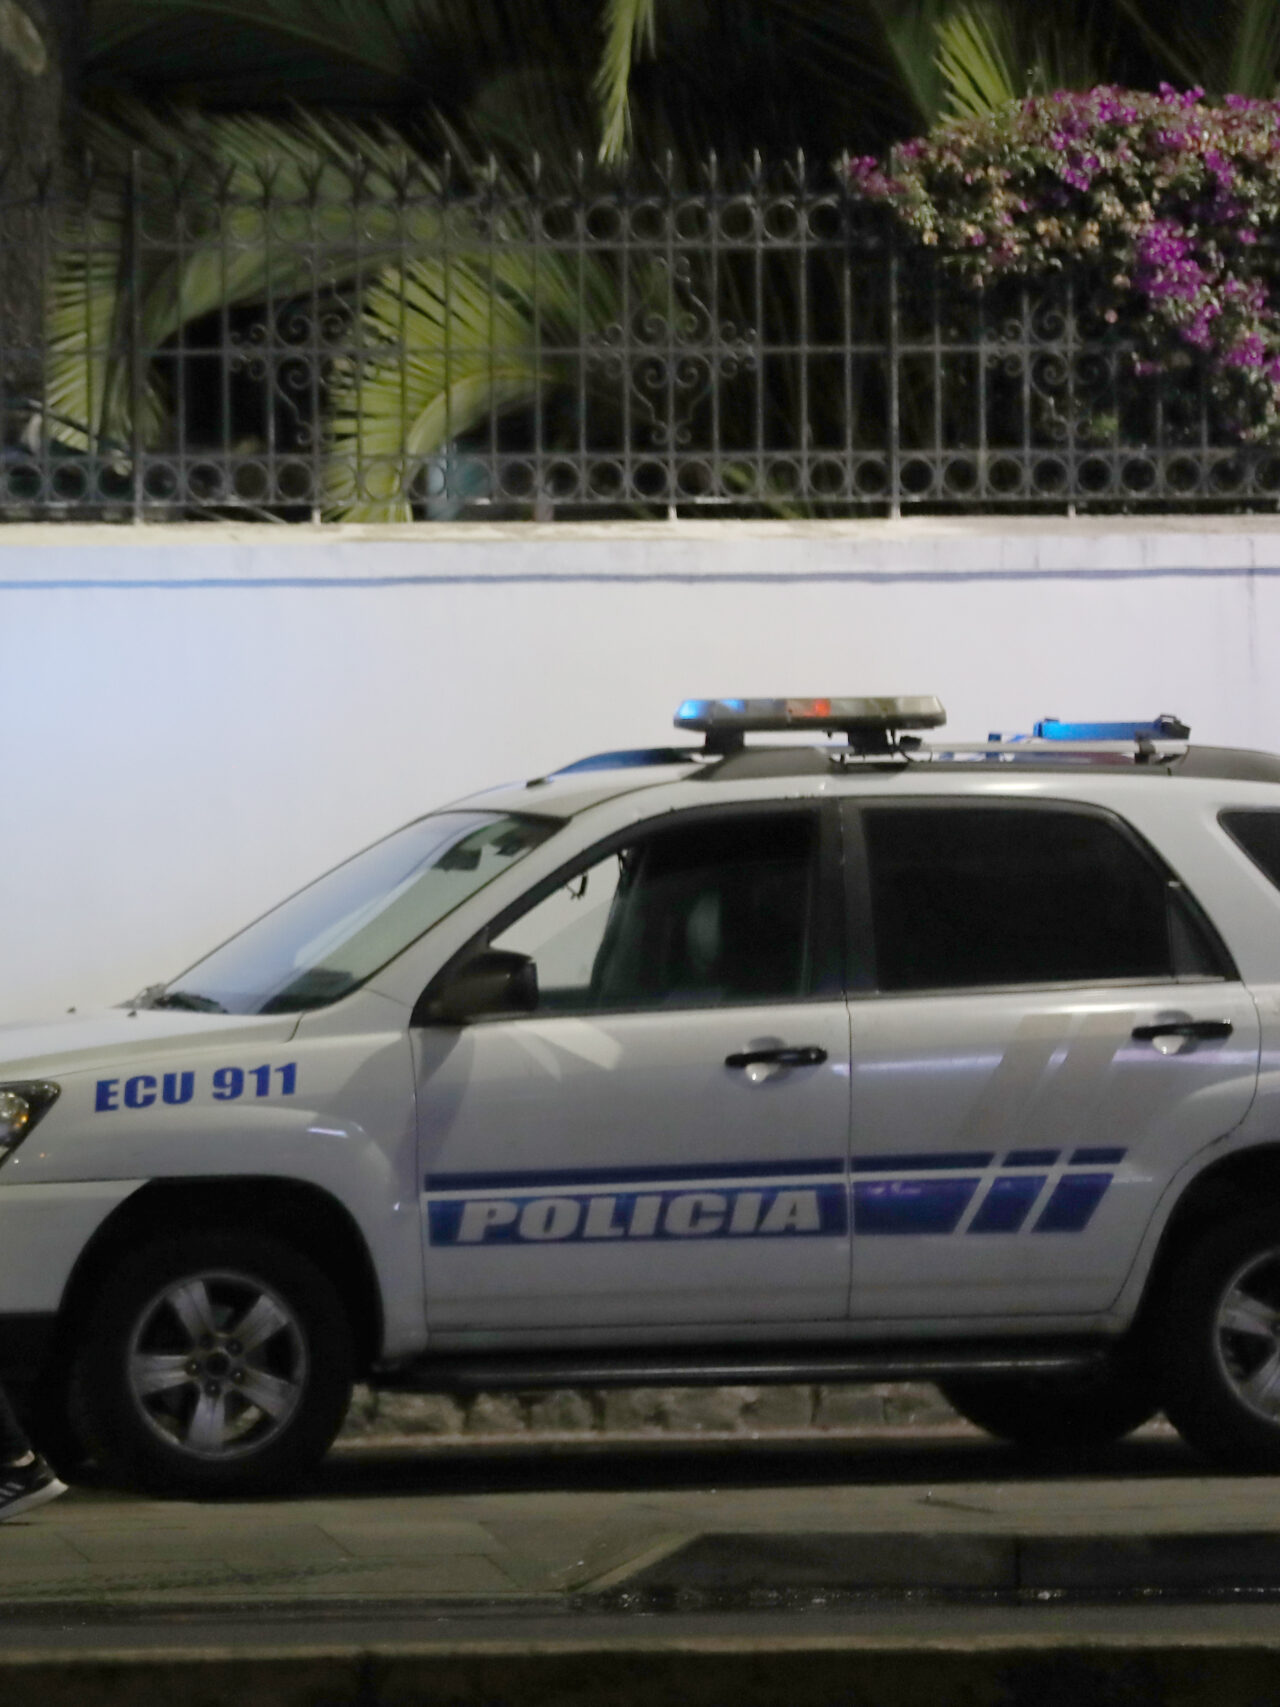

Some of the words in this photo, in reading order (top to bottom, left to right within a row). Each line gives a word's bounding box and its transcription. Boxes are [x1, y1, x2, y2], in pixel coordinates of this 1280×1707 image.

[95, 1070, 195, 1112] ECU
[212, 1062, 297, 1101] 911
[457, 1189, 820, 1242] POLICIA
